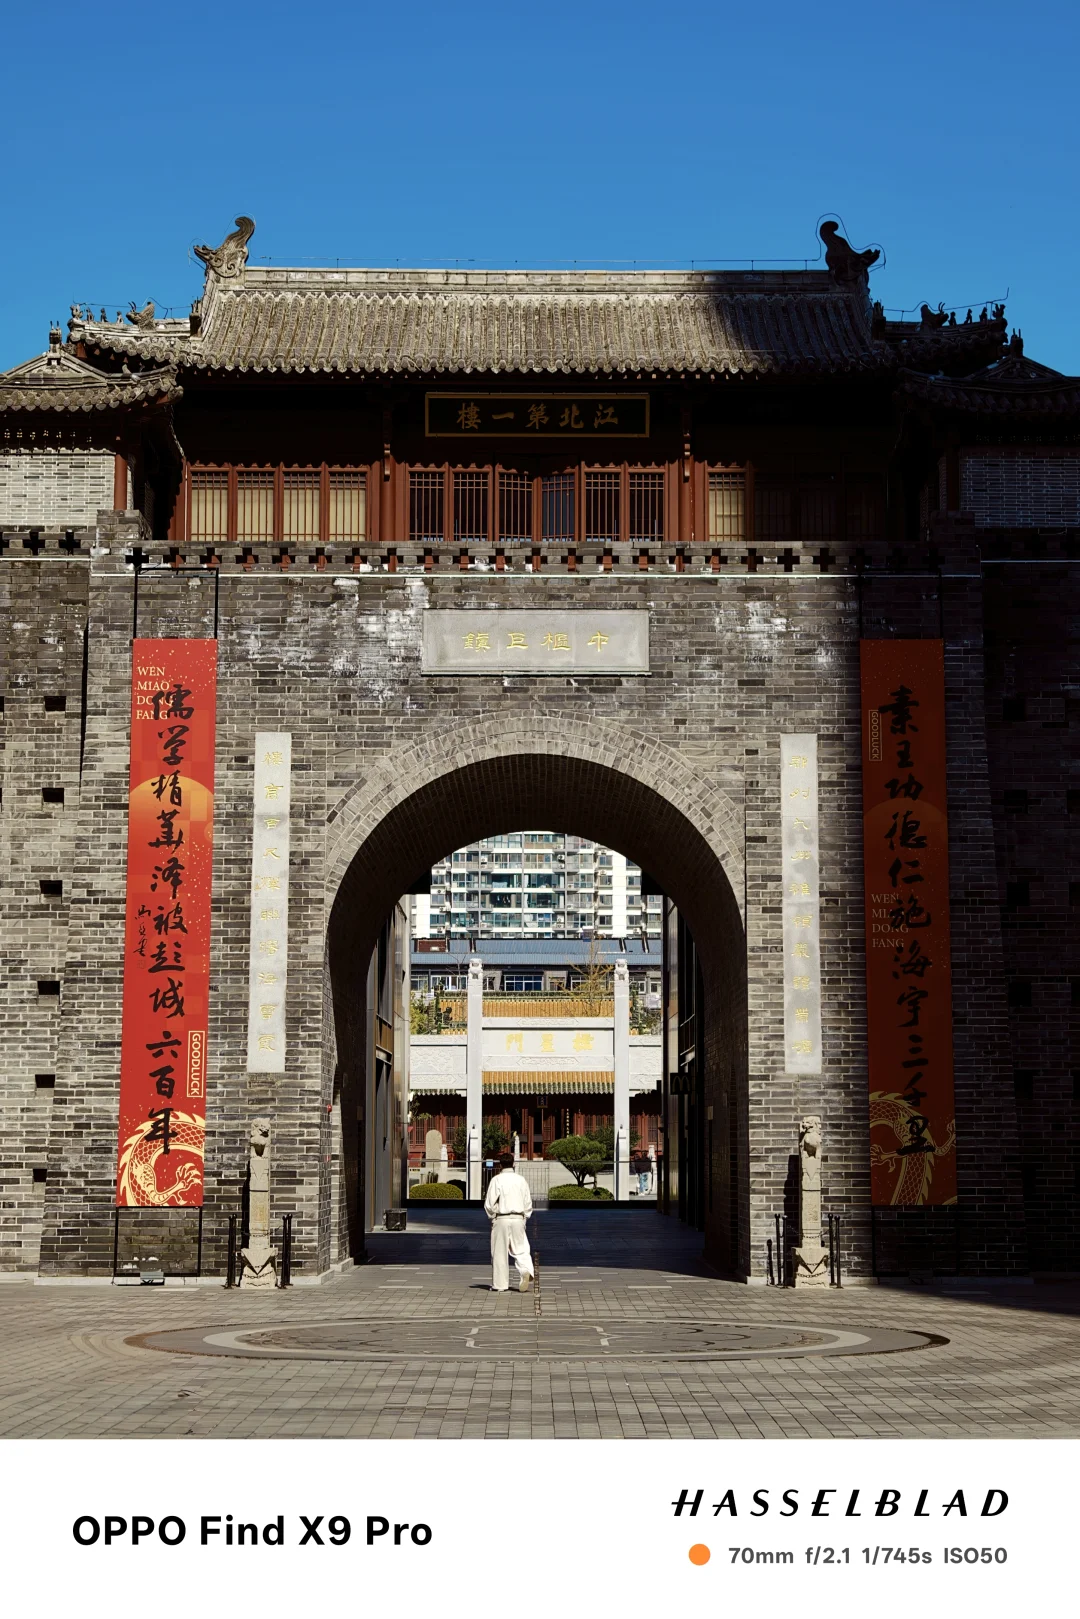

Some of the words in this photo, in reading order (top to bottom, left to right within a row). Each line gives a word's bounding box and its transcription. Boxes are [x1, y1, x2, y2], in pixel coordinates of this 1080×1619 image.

[456, 402, 619, 430] 江北第一樓
[137, 666, 166, 677] WEN
[136, 681, 170, 691] MIAO
[871, 711, 880, 760] GOODLUCK
[871, 893, 900, 904] WEN
[872, 938, 905, 948] FANG
[191, 1033, 202, 1096] GOODLUCK
